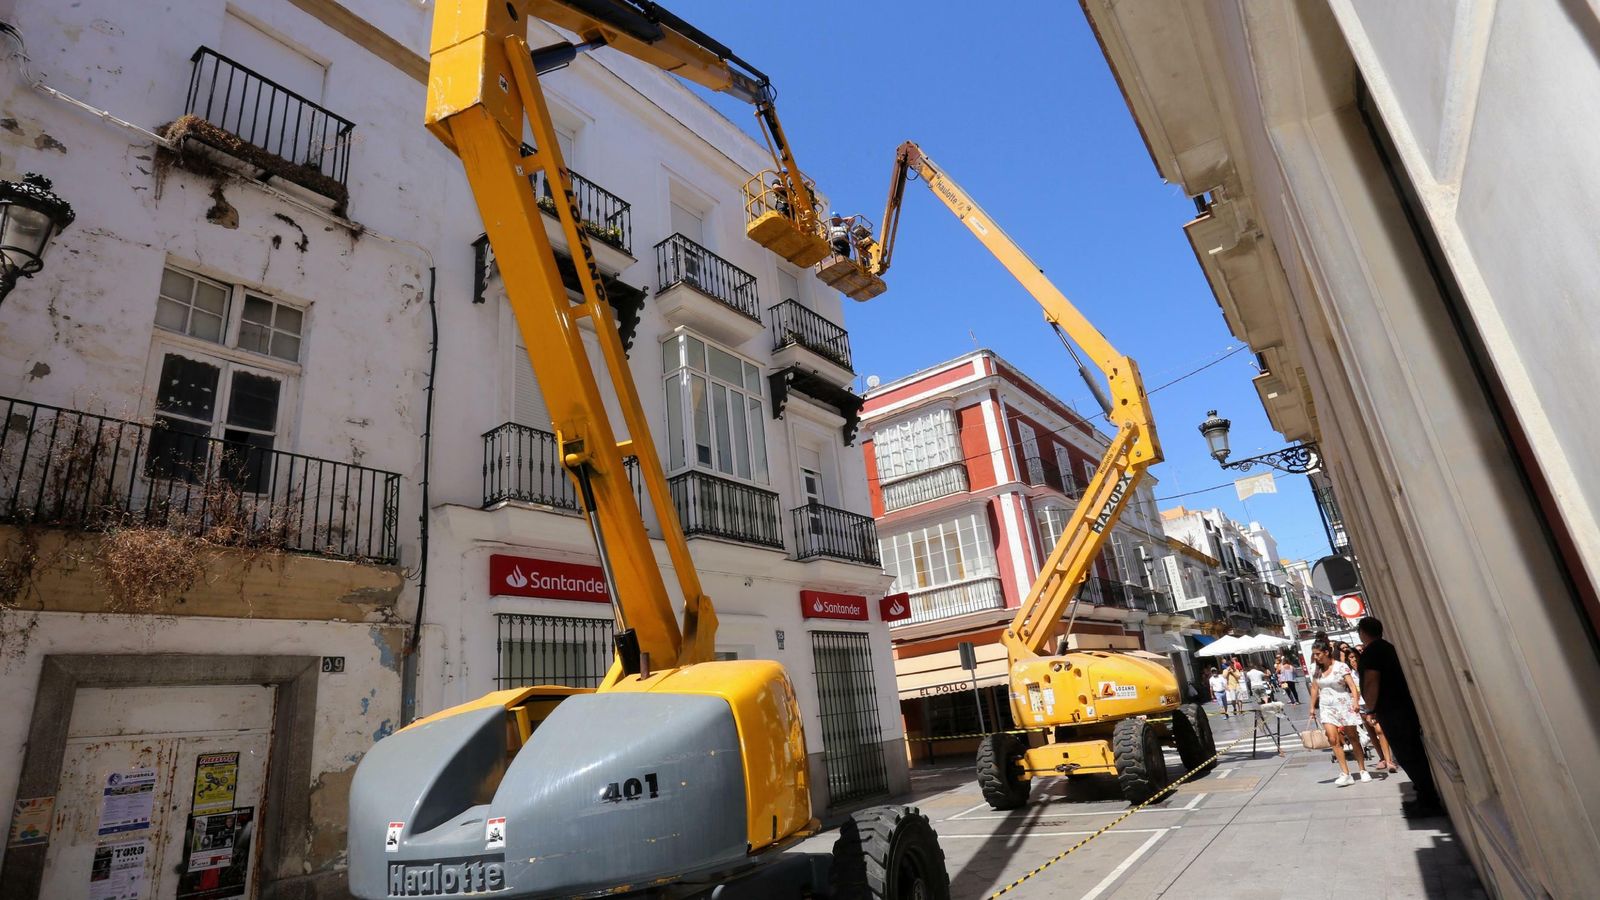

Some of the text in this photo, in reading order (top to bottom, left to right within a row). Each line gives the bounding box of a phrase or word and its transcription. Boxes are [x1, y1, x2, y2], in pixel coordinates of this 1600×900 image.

[1092, 473, 1132, 534] HA20PX
[823, 601, 860, 615] Santander
[920, 682, 967, 696] EL POLLO
[602, 773, 659, 803] 401
[389, 861, 506, 896] Haulotte
